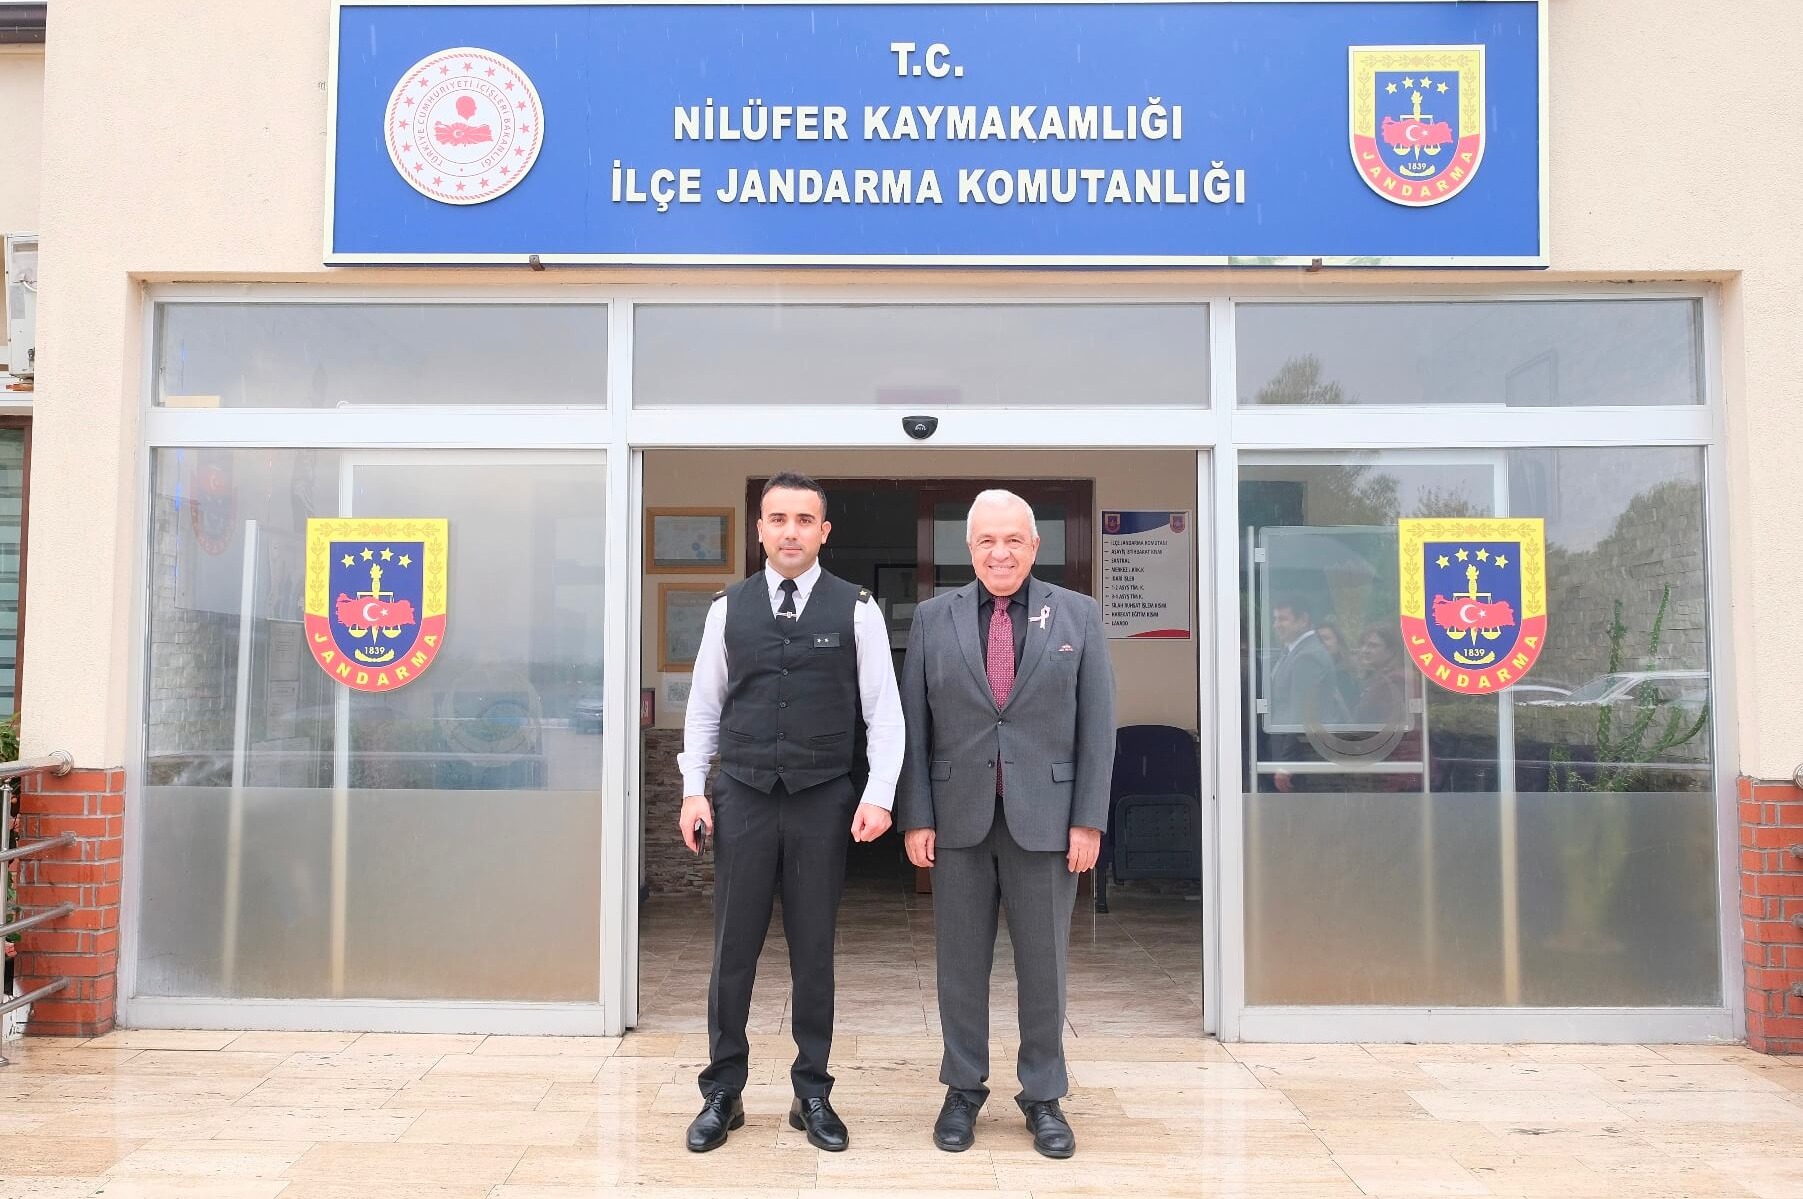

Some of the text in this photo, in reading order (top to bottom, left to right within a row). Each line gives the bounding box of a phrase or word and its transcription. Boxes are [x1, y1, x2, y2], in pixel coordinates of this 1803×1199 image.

[890, 43, 964, 78] T.C.
[674, 96, 1183, 141] NİLÜFER KAYMAKAMLIĞI
[612, 160, 1246, 212] İLÇE JANDARMA KOMUTANLIĞI
[1363, 151, 1473, 197] JANDARMA
[1407, 162, 1428, 171] 1839
[314, 632, 438, 686] JANDARMA
[364, 646, 386, 656] 1839
[1411, 635, 1538, 689] JANDARMA
[1463, 648, 1486, 658] 1839
